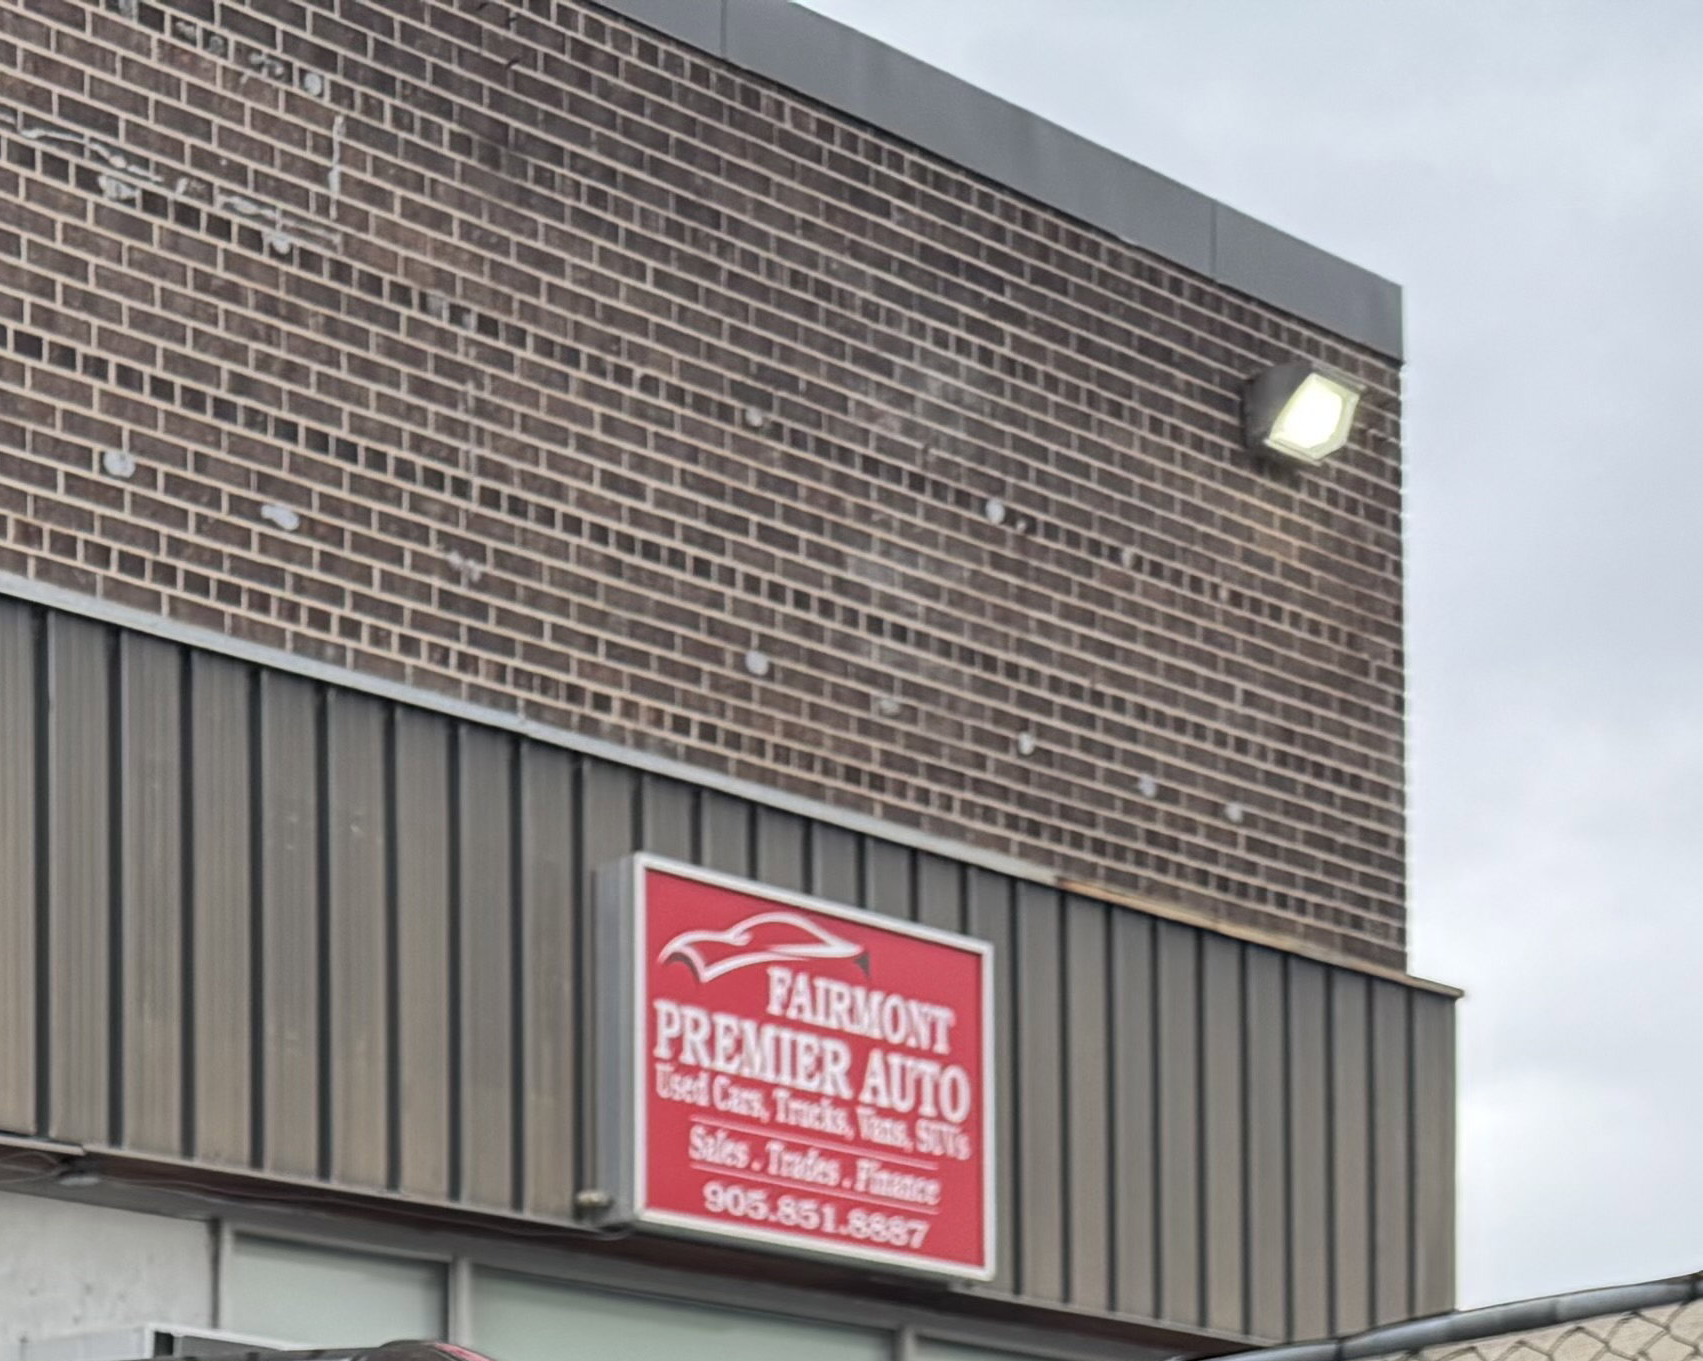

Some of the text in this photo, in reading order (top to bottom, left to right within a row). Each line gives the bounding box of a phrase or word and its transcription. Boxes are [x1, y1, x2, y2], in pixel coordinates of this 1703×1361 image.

[766, 965, 956, 1056] FAIRMONT
[653, 998, 973, 1124] PREMIER AUTO
[655, 1062, 710, 1107] Used
[712, 1073, 770, 1125] Cars,
[771, 1087, 855, 1142] Trucks,
[689, 1123, 942, 1207] Sales Trades Finance
